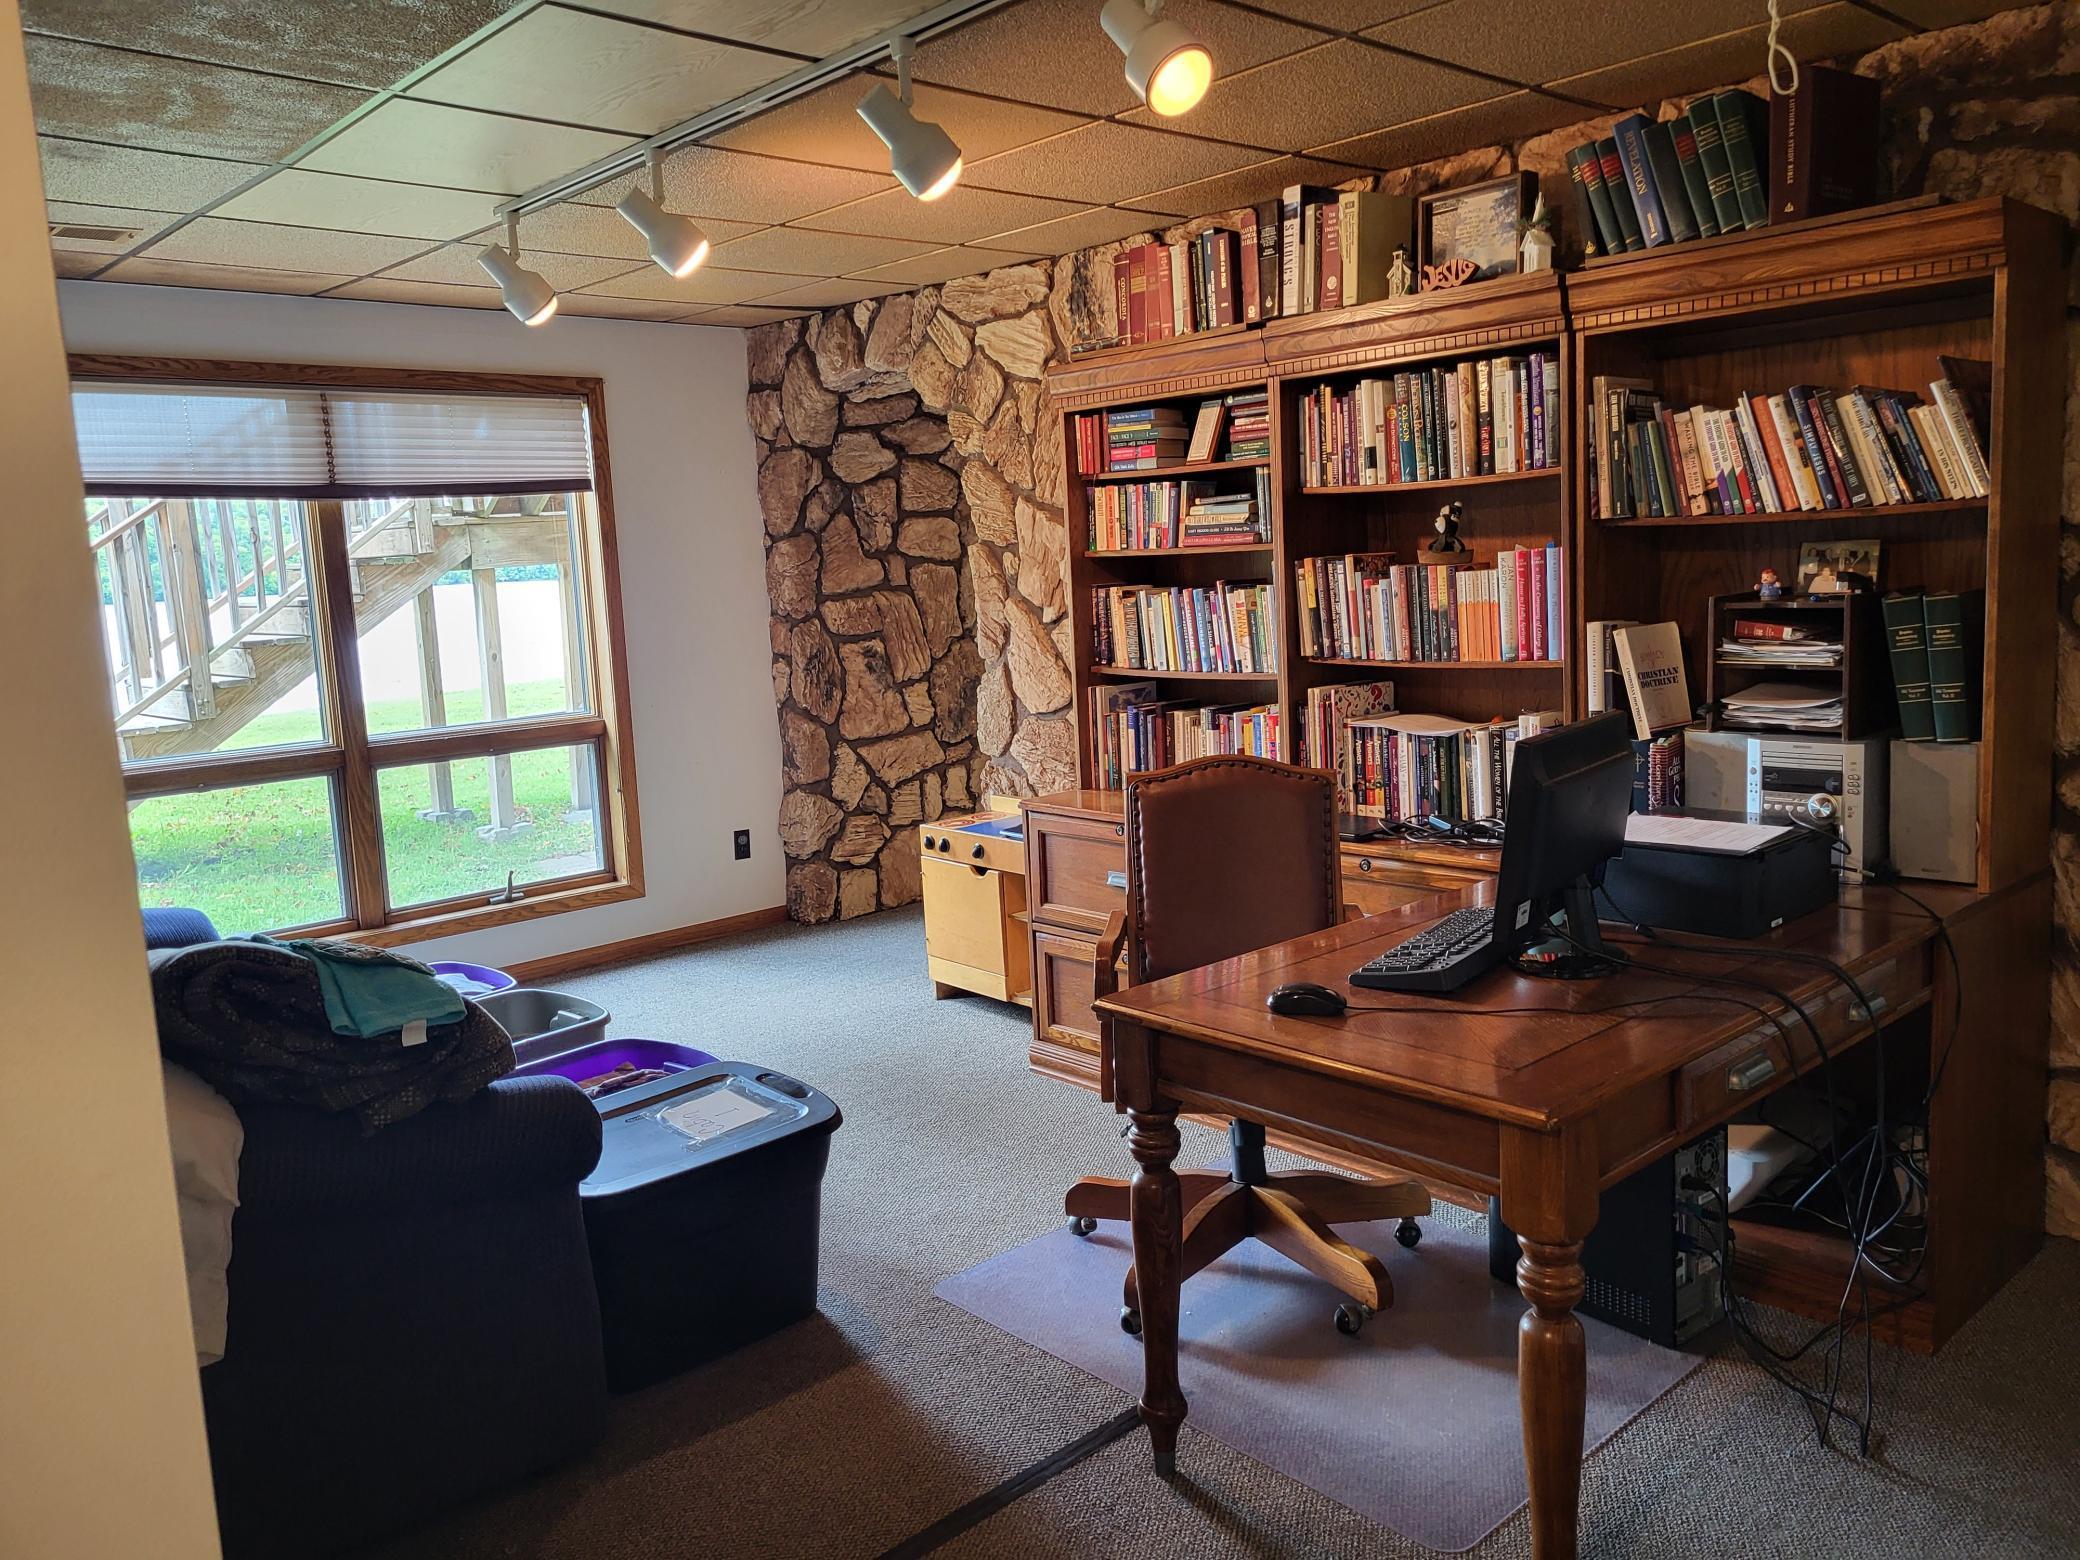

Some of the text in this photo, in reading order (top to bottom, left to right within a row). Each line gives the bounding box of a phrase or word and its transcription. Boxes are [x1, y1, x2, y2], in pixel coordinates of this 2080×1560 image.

[1624, 131, 1648, 195] REVELATION
[1786, 164, 1794, 185] BIBLE
[1284, 223, 1294, 285] STRONG'S
[1401, 404, 1409, 442] COLSON
[1684, 422, 1696, 454] WALKING
[1691, 471, 1700, 490] BIBLE
[1801, 422, 1827, 476] SIMPLY JESUS
[1939, 456, 1949, 469] HIS
[1944, 468, 1959, 491] STEPS
[1535, 627, 1543, 647] Others
[1637, 666, 1679, 680] CHRISTIAN
[1641, 675, 1679, 689] DOCTRINE
[1626, 667, 1642, 722] CHRISTIAN DOCTRINE
[1493, 736, 1502, 748] ALL
[1494, 762, 1502, 786] WOMEN
[1496, 786, 1501, 794] OF
